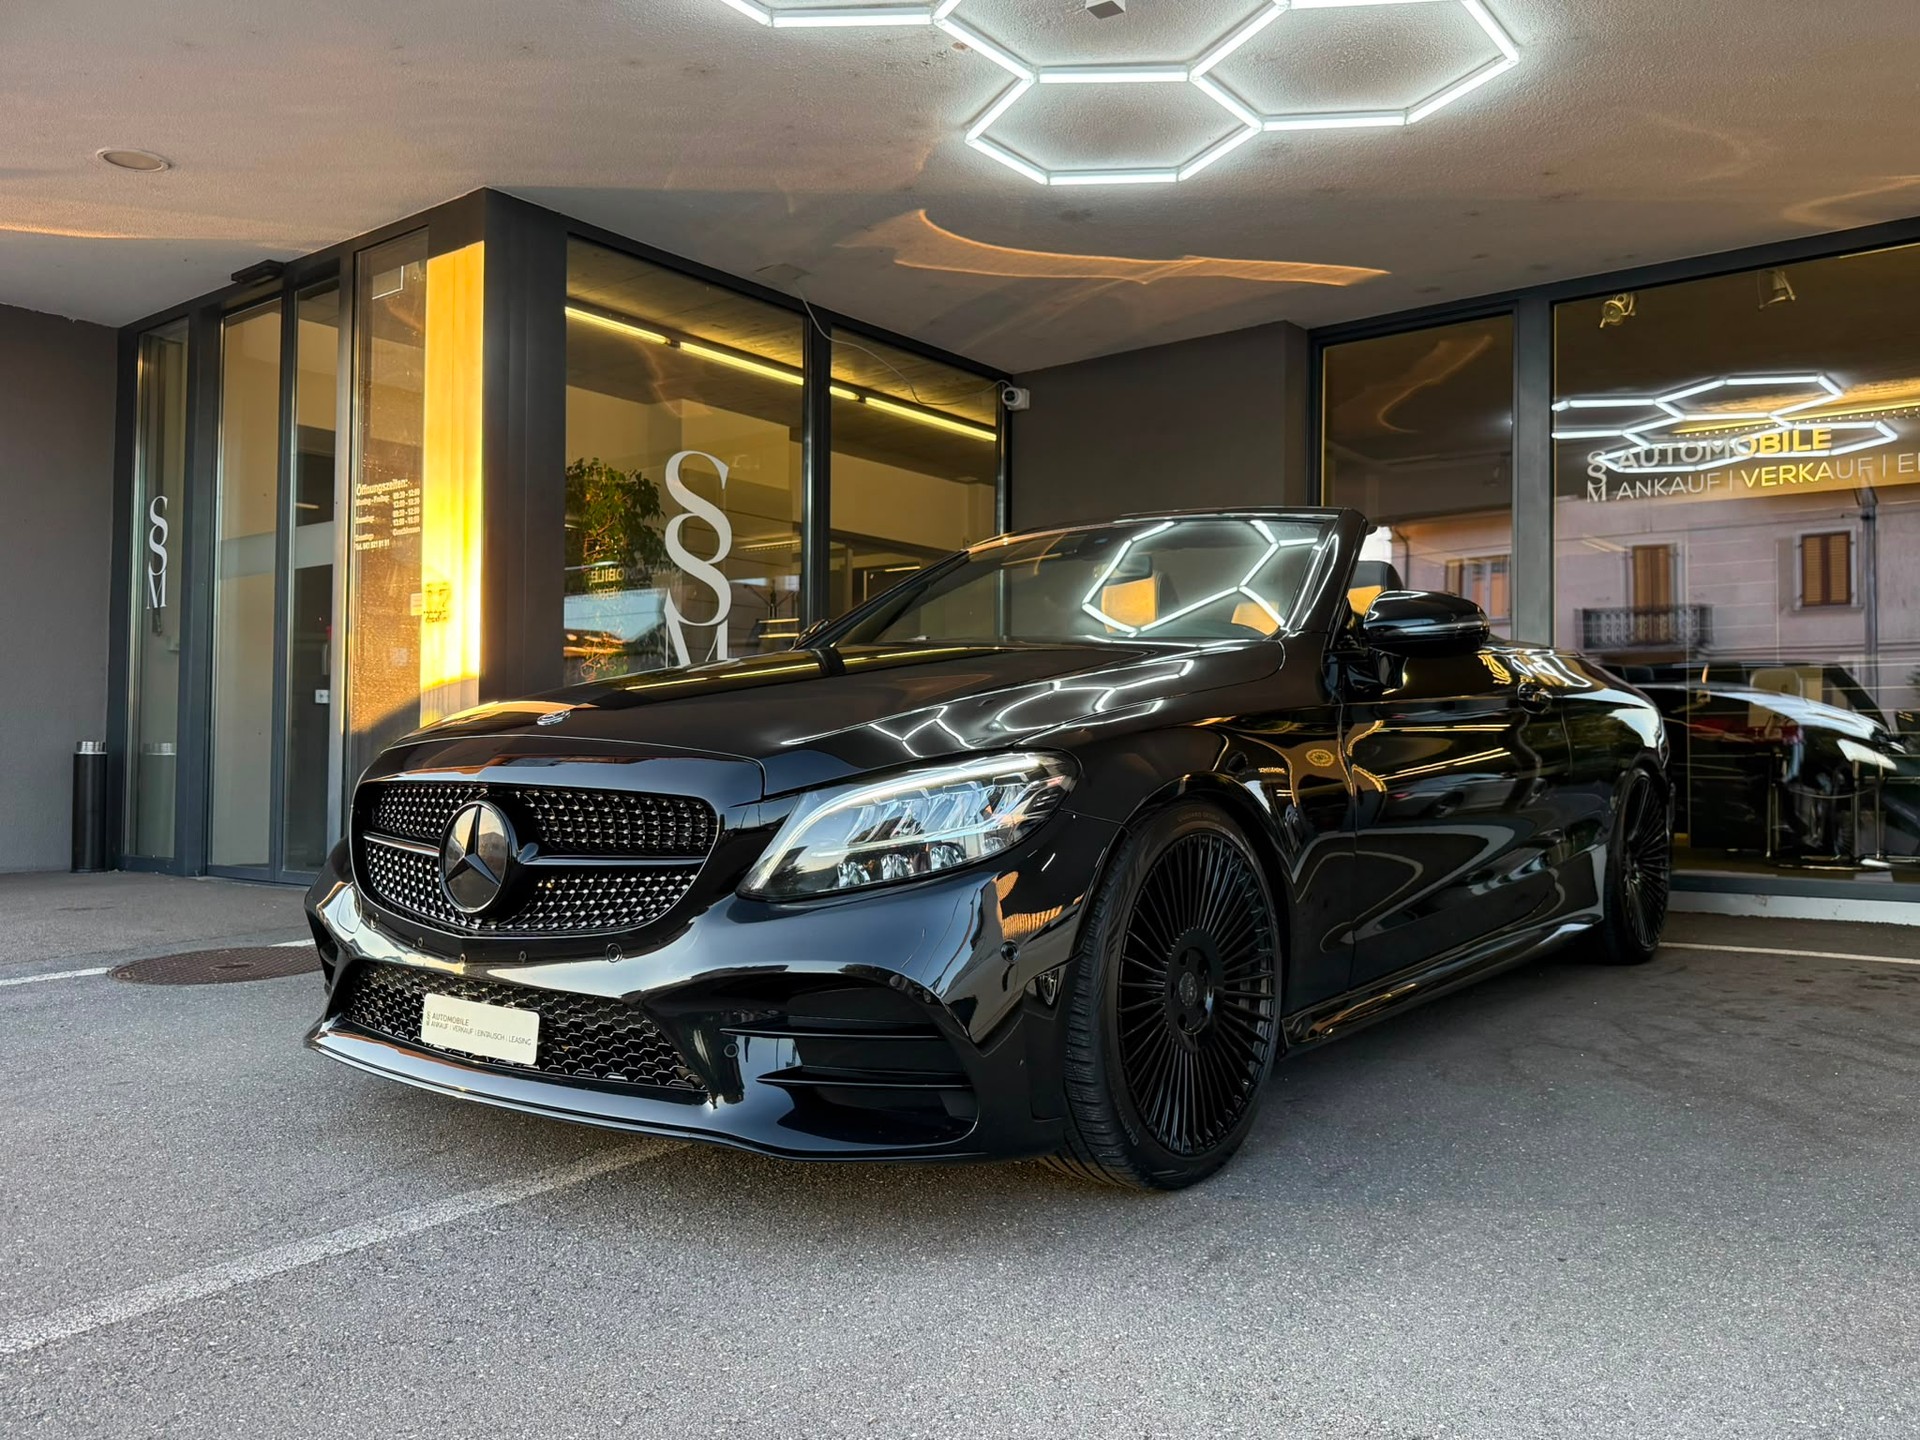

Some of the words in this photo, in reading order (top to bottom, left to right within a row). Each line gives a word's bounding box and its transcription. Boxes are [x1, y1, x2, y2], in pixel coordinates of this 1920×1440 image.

[1619, 427, 1832, 468] AUTOMOBILE
[1616, 472, 1721, 501] ANKAUF
[1740, 456, 1873, 488] VERKAUF
[432, 1012, 470, 1026] AUTOMOBILE
